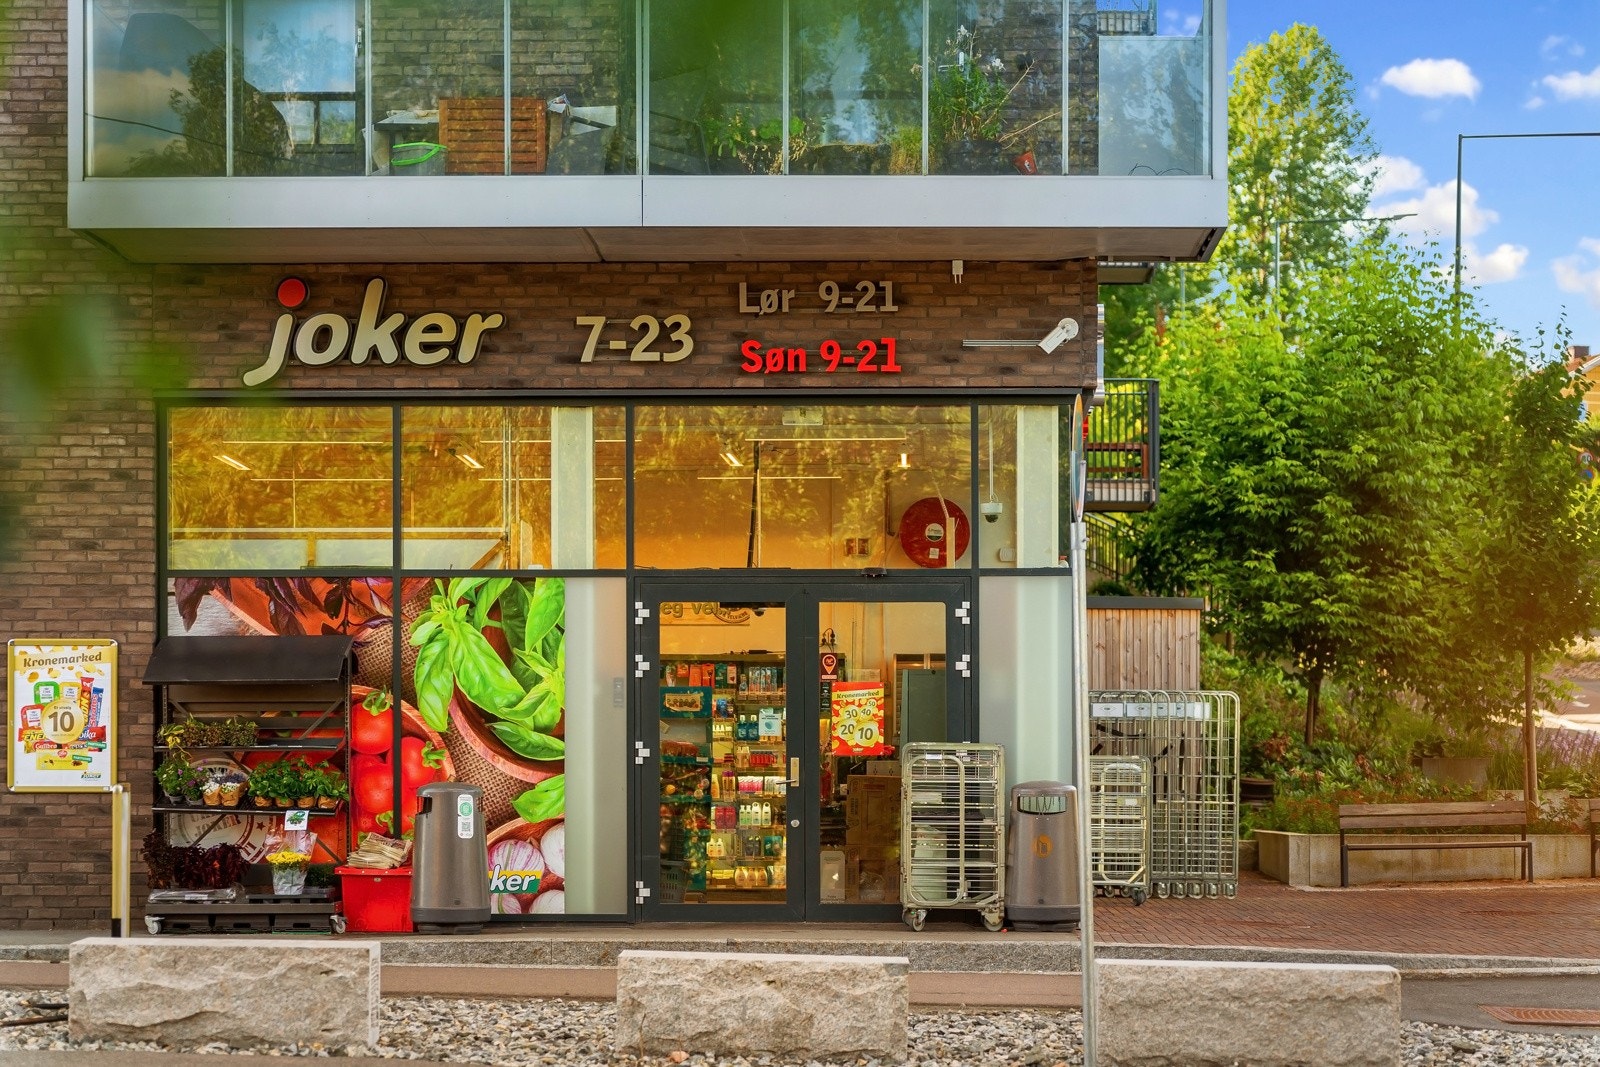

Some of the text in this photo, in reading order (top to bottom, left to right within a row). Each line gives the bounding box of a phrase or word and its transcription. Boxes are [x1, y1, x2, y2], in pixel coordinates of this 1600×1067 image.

[738, 280, 899, 316] Lør 9-21
[242, 277, 505, 387] joker
[575, 314, 695, 363] 7-23
[740, 338, 902, 374] Søn 9-21
[23, 652, 102, 668] Kronemarked
[836, 690, 880, 699] Kronemarked
[845, 708, 858, 719] 30
[861, 708, 872, 716] 40
[48, 711, 75, 732] 10
[840, 723, 855, 735] 20
[858, 727, 874, 740] 10
[490, 863, 537, 891] ker
